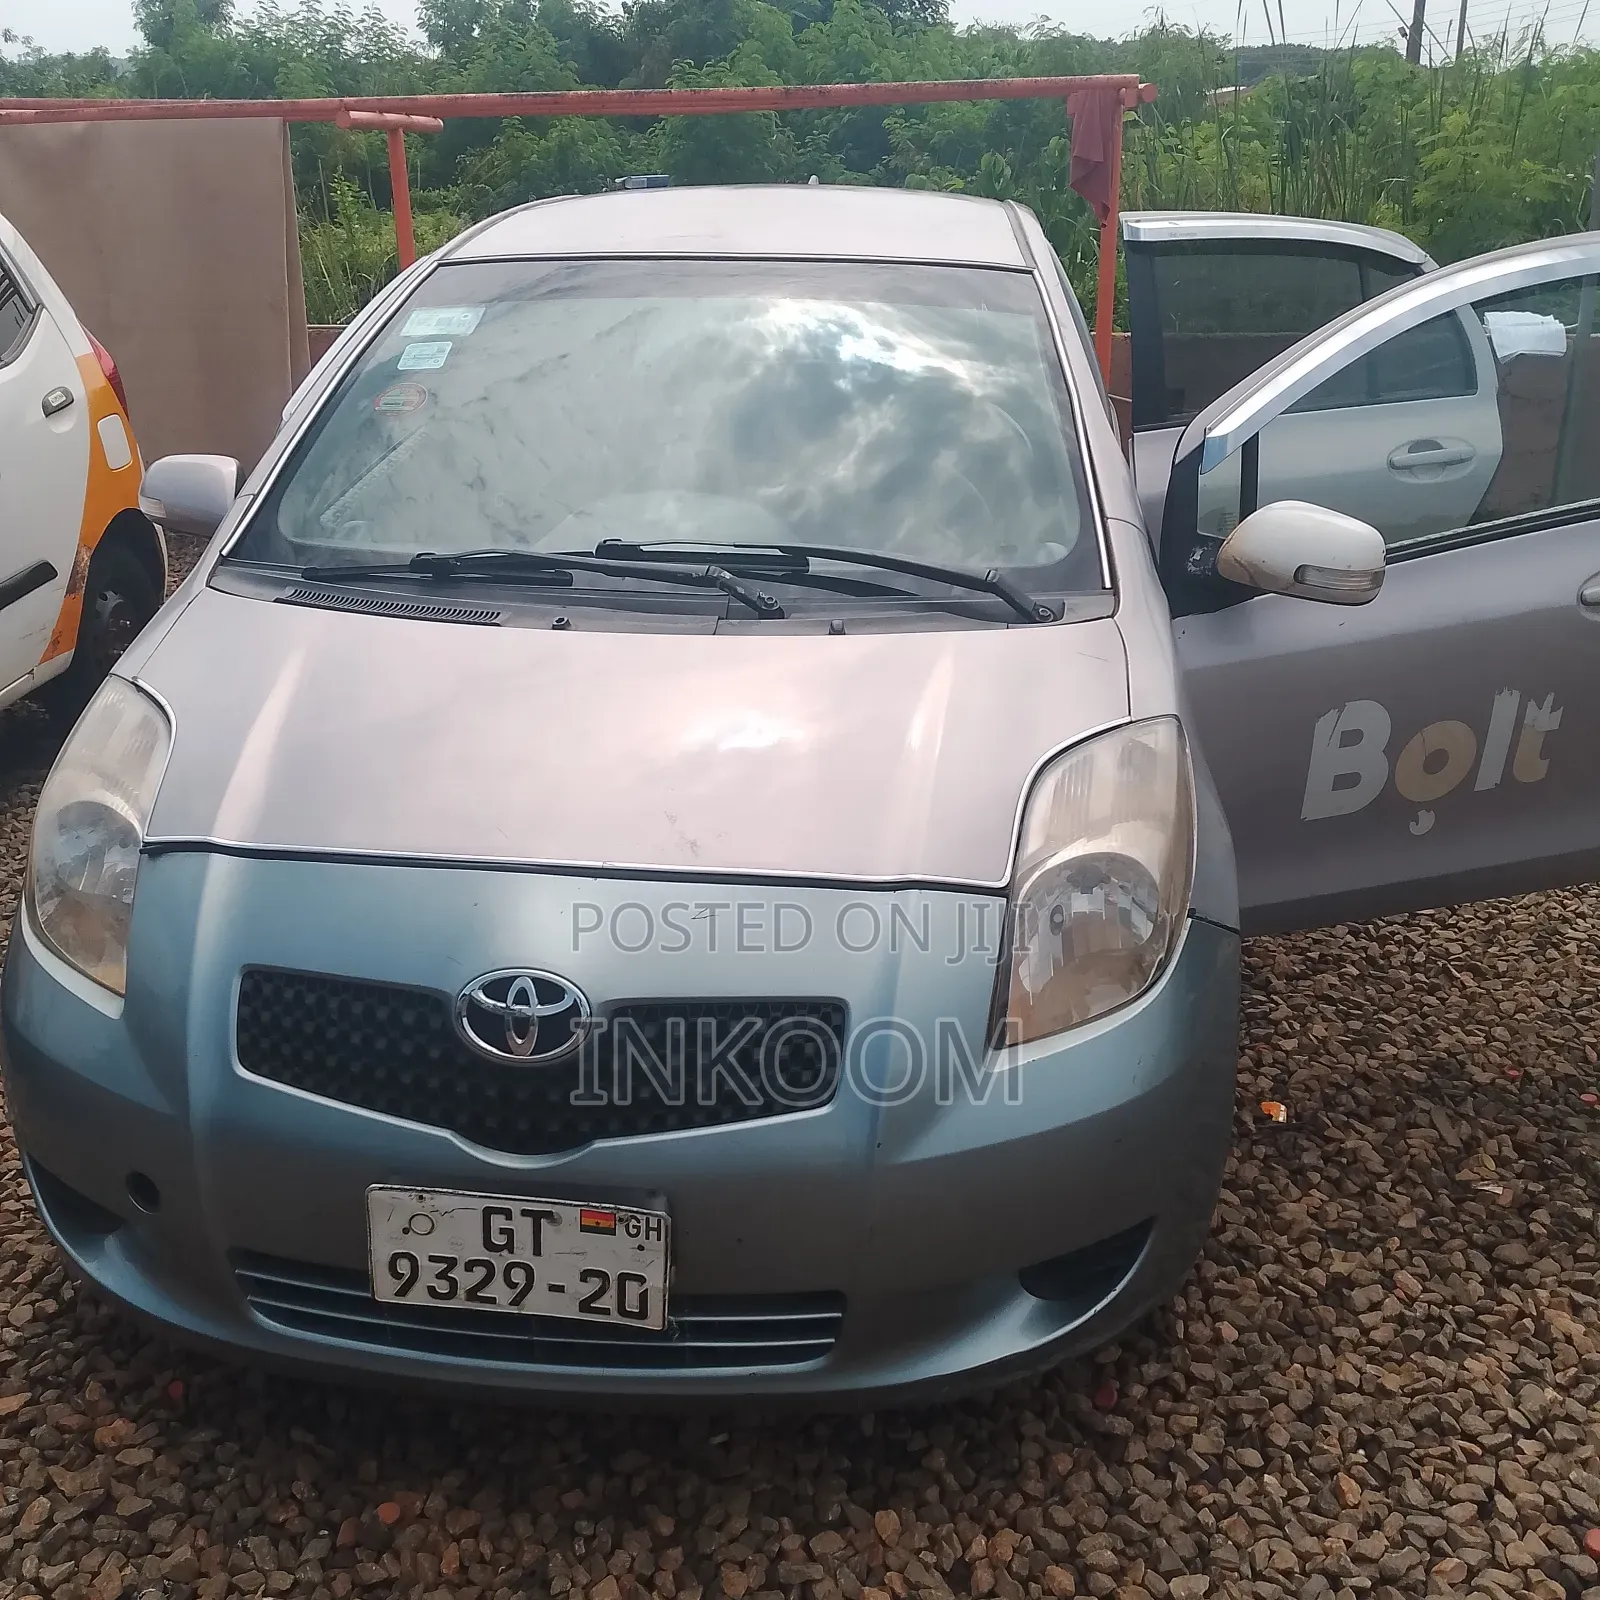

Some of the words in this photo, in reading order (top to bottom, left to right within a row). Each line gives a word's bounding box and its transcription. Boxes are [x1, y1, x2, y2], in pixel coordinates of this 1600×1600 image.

[1301, 686, 1563, 835] Bolt
[482, 1206, 554, 1257] GT
[624, 1215, 662, 1242] GH
[388, 1251, 649, 1321] 9329-20
